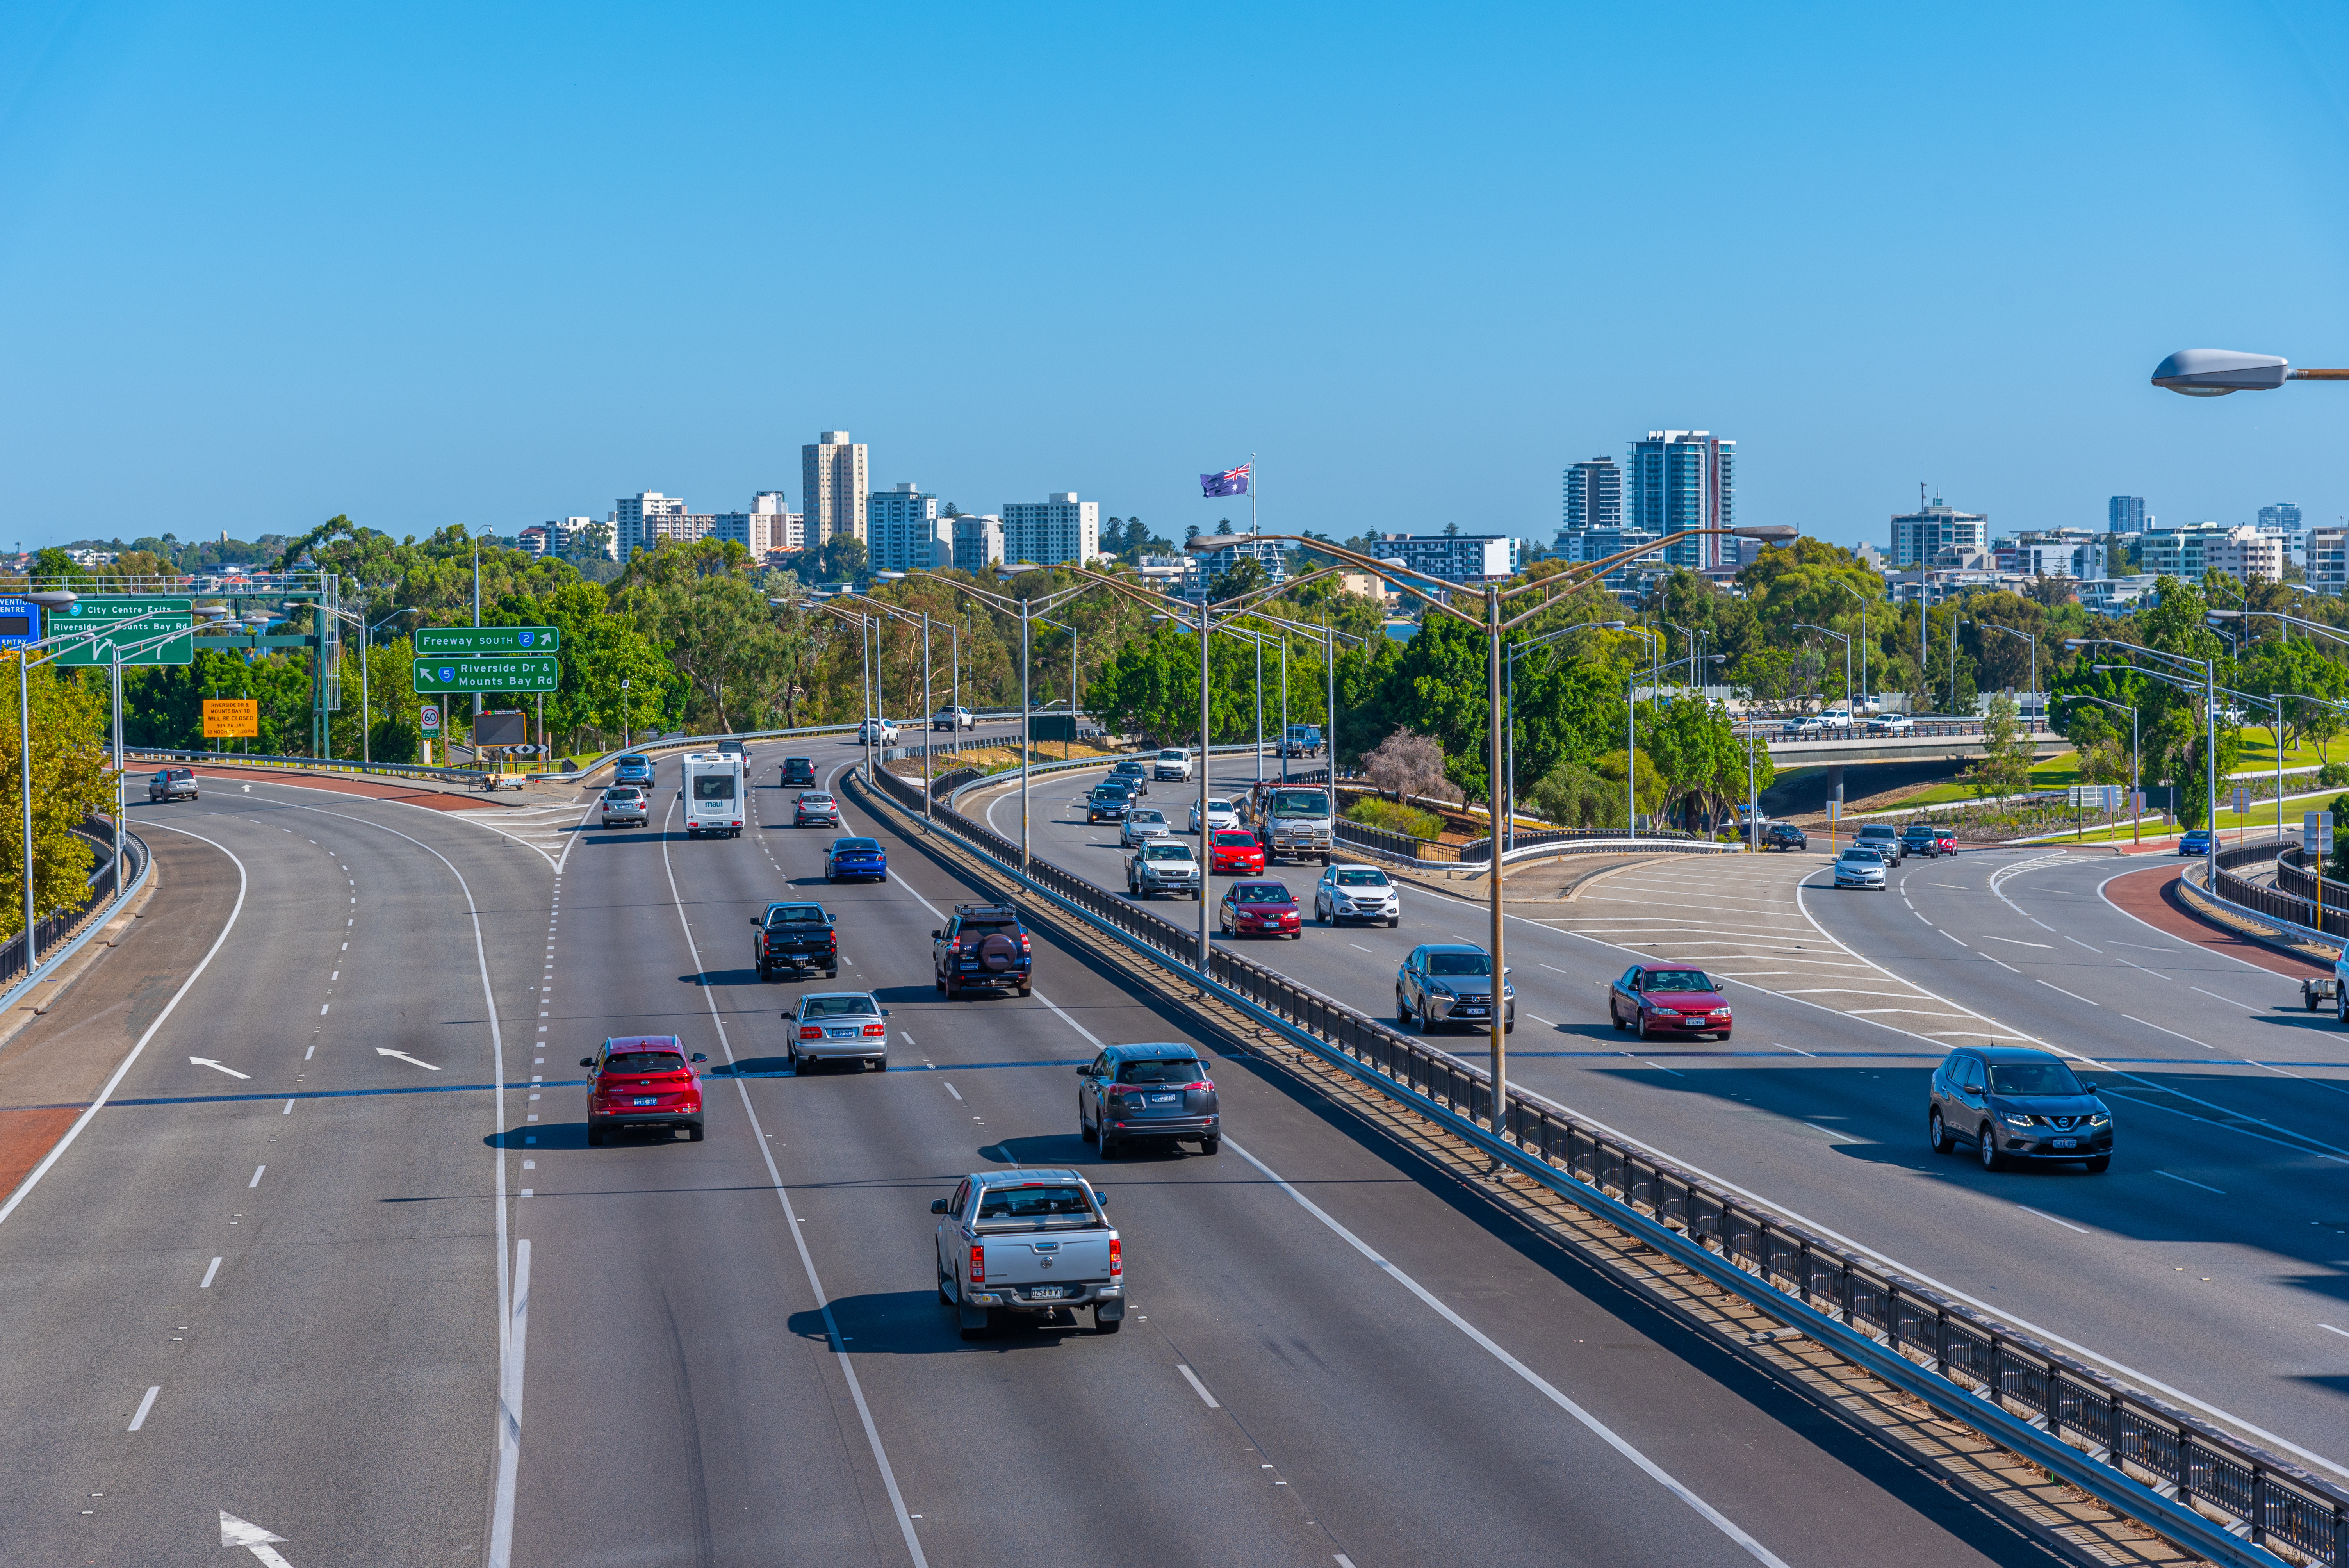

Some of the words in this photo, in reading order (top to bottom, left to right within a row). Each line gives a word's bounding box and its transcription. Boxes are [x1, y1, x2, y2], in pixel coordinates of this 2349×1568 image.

[88, 606, 106, 615] City
[153, 623, 171, 631] Bay
[424, 637, 472, 646] Freeway
[461, 664, 516, 673] Riverside
[459, 677, 503, 686] Mounts
[509, 677, 531, 686] Bay
[538, 676, 552, 684] Rd
[424, 713, 436, 722] 60
